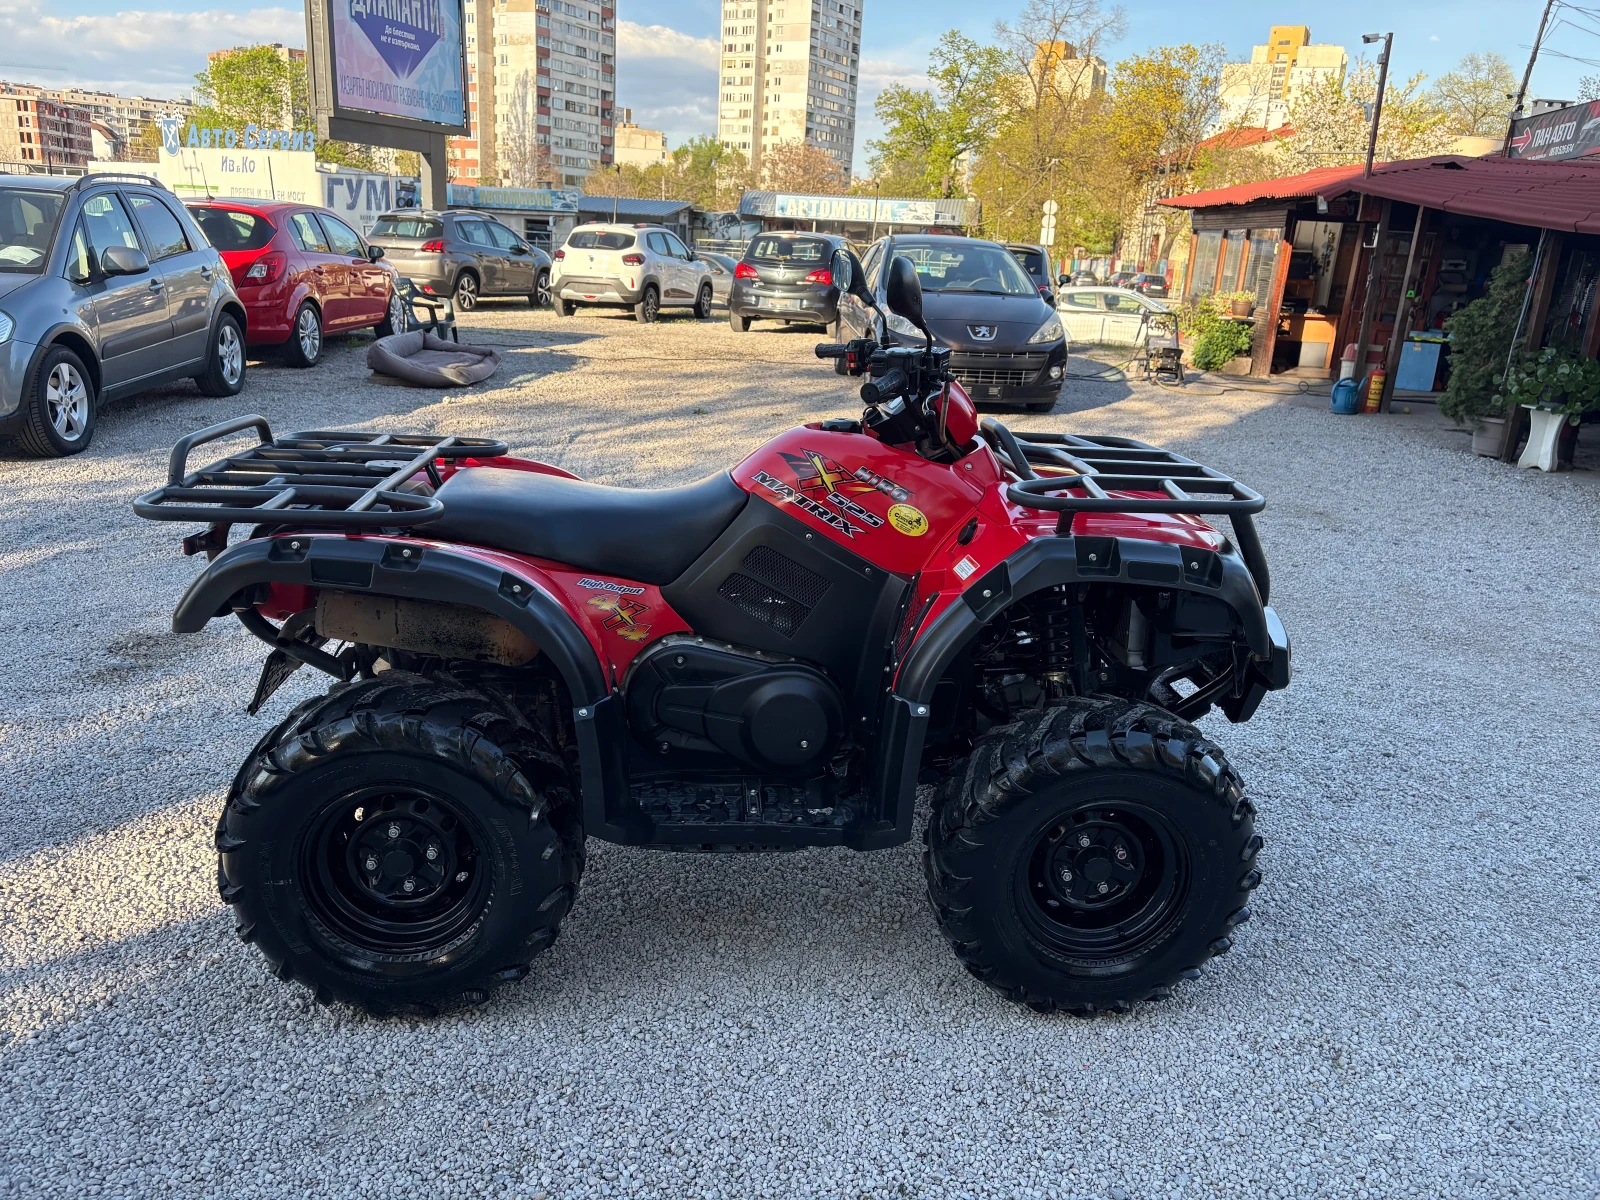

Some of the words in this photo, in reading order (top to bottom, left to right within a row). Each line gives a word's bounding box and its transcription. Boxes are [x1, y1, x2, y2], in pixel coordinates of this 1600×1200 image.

[340, 73, 365, 96] ХАЗАРТЪТ
[365, 78, 380, 99] НОСИ
[380, 81, 392, 103] РИСК
[392, 83, 399, 104] ОТ
[399, 83, 425, 109] РАЗВИВАНЕ
[1549, 121, 1577, 144] АВТО
[264, 189, 286, 201] ЗАЕН
[287, 190, 306, 202] МОСТ
[478, 188, 553, 207] АВТОМИВКА
[786, 198, 892, 221] АВТОМИВКА
[853, 465, 912, 503] HIRO
[750, 468, 869, 541] MATRIX
[826, 491, 885, 528] 525
[577, 577, 604, 591] High
[603, 581, 646, 596] Output
